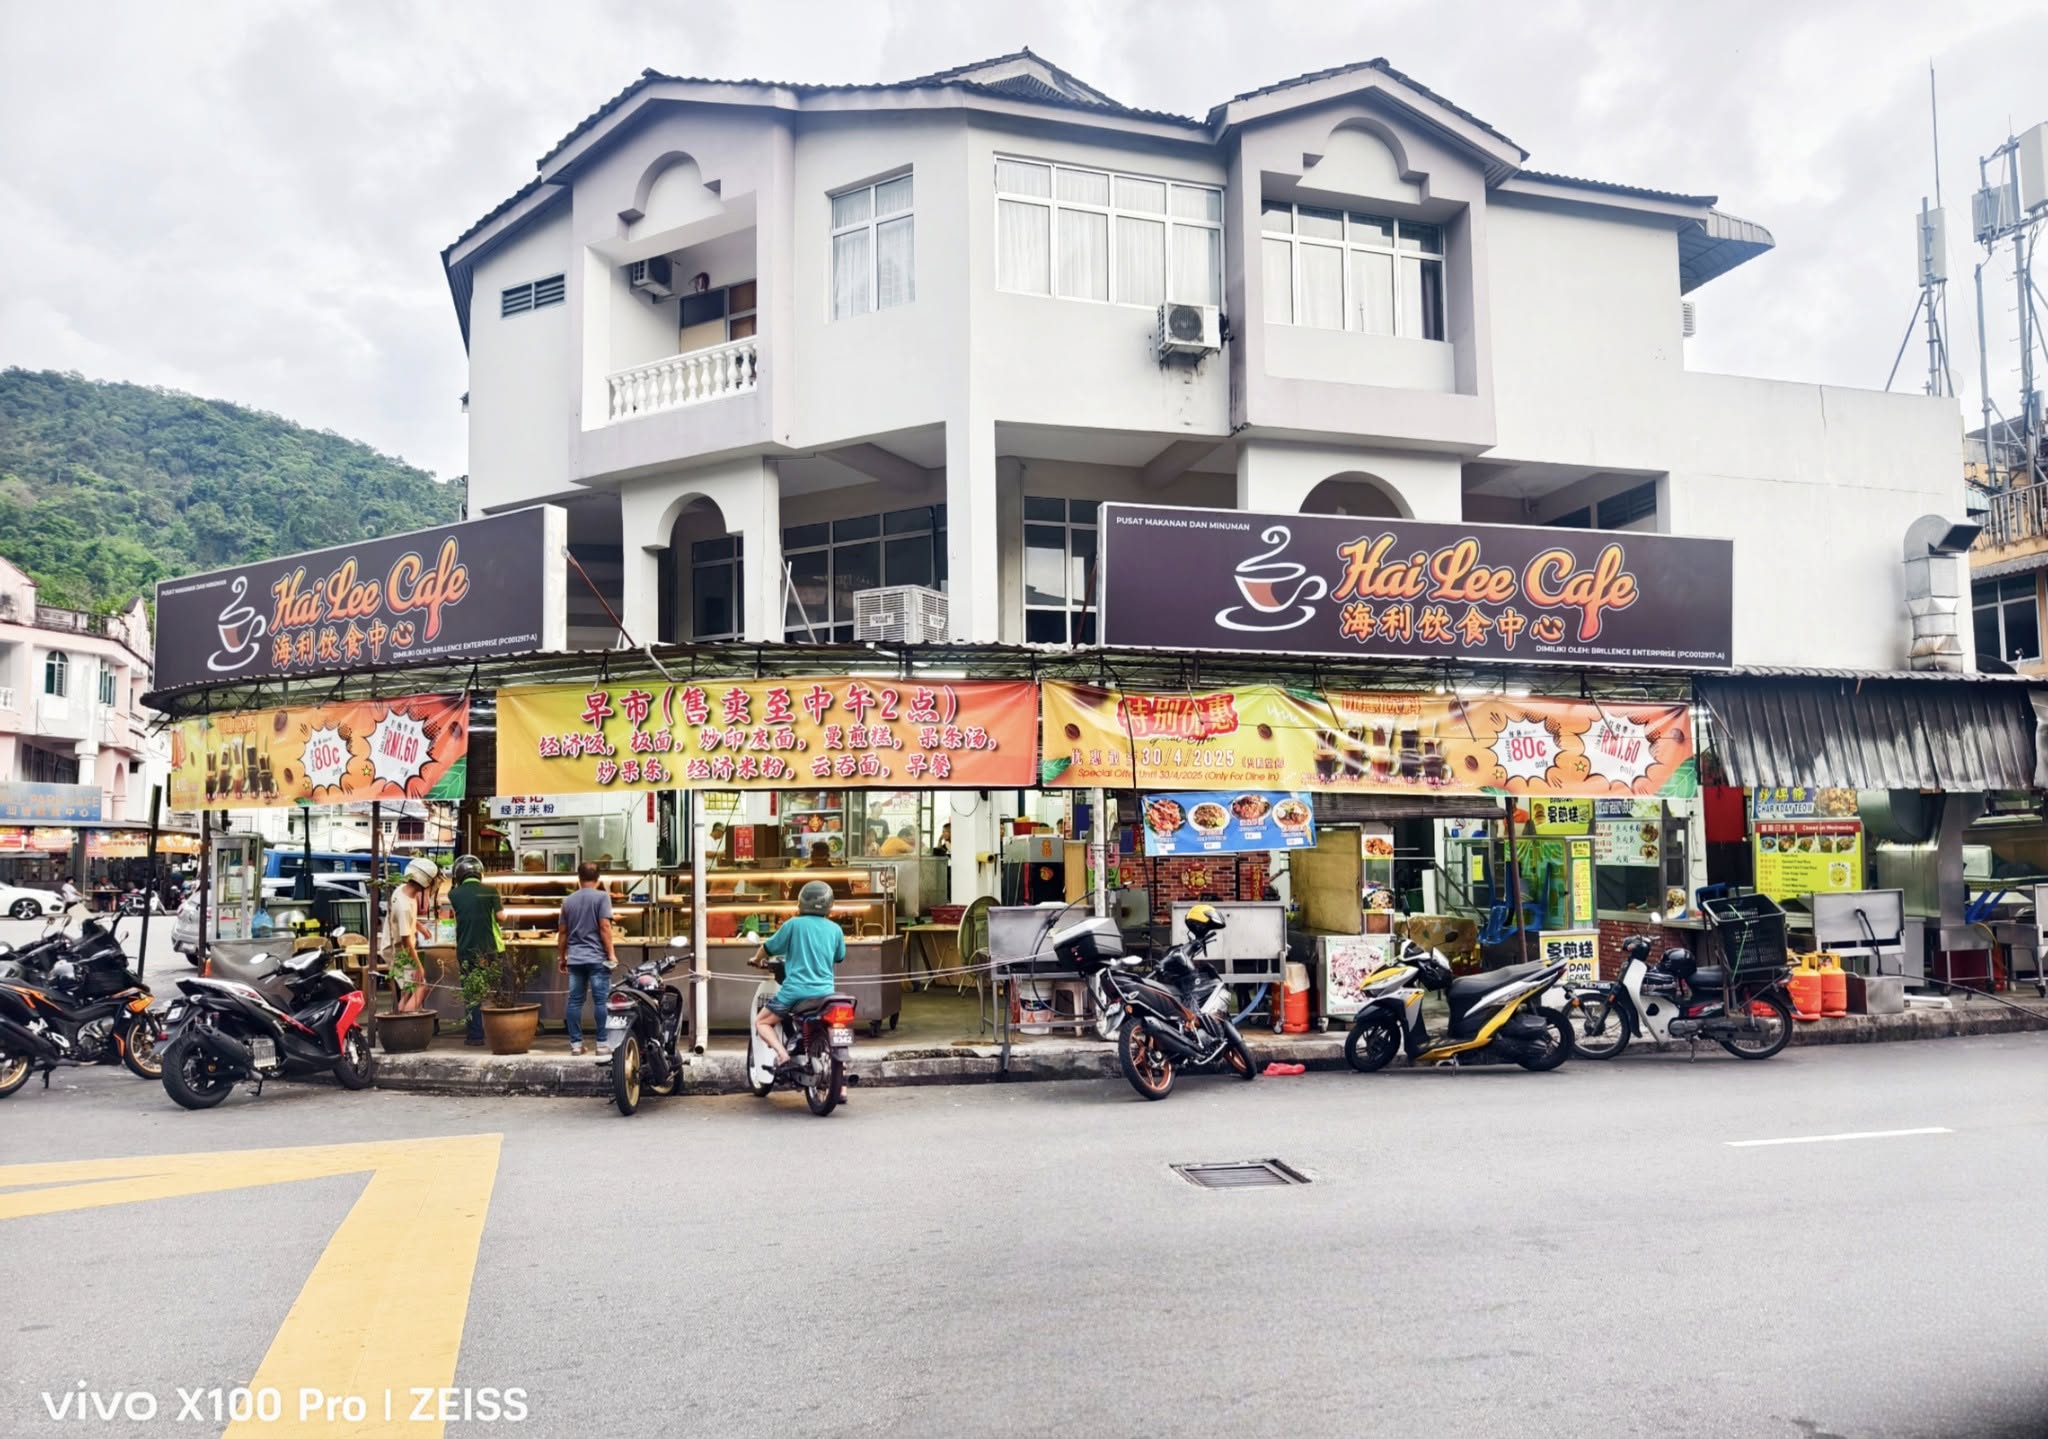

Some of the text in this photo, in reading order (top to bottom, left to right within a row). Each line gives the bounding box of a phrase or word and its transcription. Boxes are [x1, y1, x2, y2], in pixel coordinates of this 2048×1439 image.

[1116, 516, 1250, 531] PUSAT MAKANAN DAN MINUMAN
[269, 536, 470, 642] Hai Lee Cafe
[1331, 532, 1640, 641] Hai Lee Cafe
[463, 639, 497, 649] ENTERPRISE
[1339, 604, 1566, 650] 海利饮食中心
[272, 621, 416, 671] 海利饮食中心
[1536, 645, 1725, 660] DIMILIKI OLEH: BRILLENCE ENTERPRISE (PC0012917-A)
[1120, 695, 1237, 737] 特别优惠
[383, 729, 419, 764] RM1.60
[1078, 769, 1112, 779] Special
[1114, 769, 1134, 778] Offe
[501, 803, 554, 815] 经济米粉
